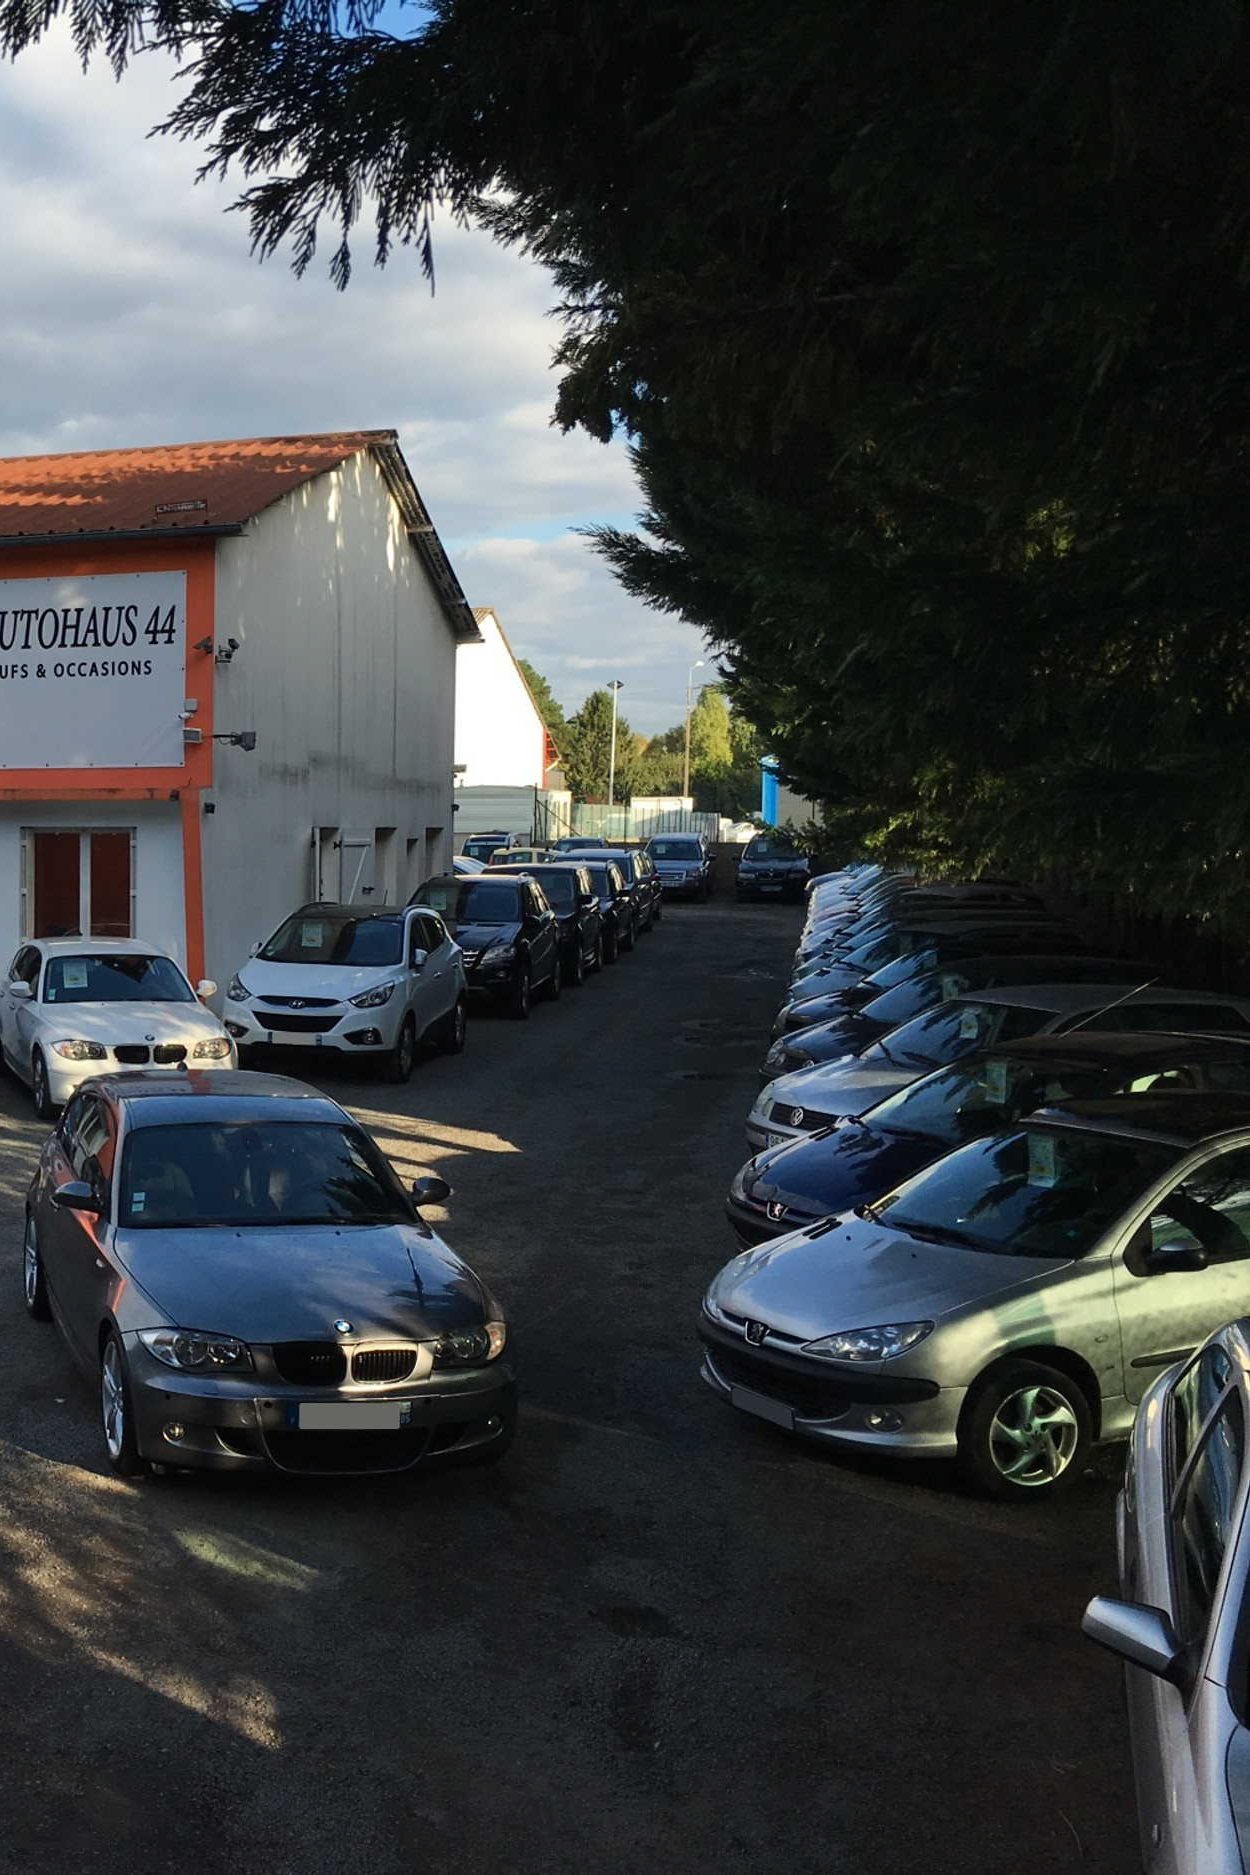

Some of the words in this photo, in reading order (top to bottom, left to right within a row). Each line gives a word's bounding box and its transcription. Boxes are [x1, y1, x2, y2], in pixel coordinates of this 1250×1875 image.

[144, 604, 176, 645] 44
[36, 663, 46, 678] &
[53, 660, 152, 677] OCCASIONS
